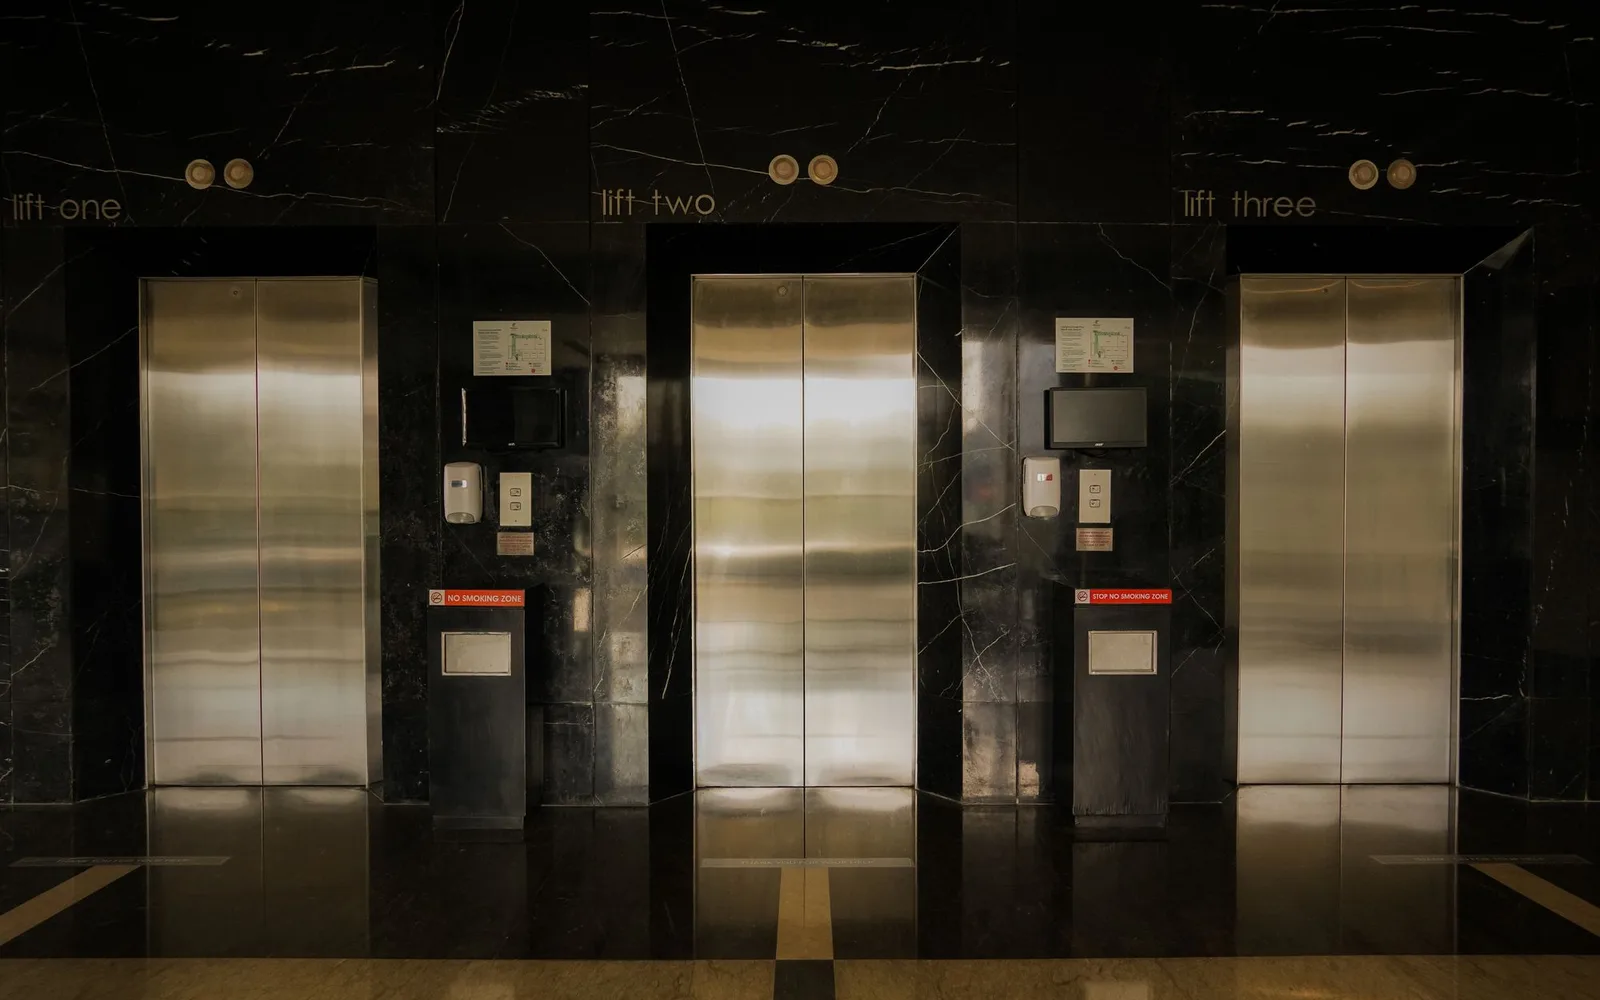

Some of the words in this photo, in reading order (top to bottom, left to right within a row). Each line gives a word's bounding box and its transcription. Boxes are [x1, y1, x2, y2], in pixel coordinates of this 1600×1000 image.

[12, 193, 45, 220] lift
[59, 199, 122, 220] one
[602, 189, 635, 215] lift
[652, 189, 715, 215] two
[1184, 189, 1216, 217] lift
[1232, 190, 1316, 218] three
[447, 594, 461, 602] NO
[462, 594, 500, 602] SMOKING
[501, 595, 522, 603] ZONE
